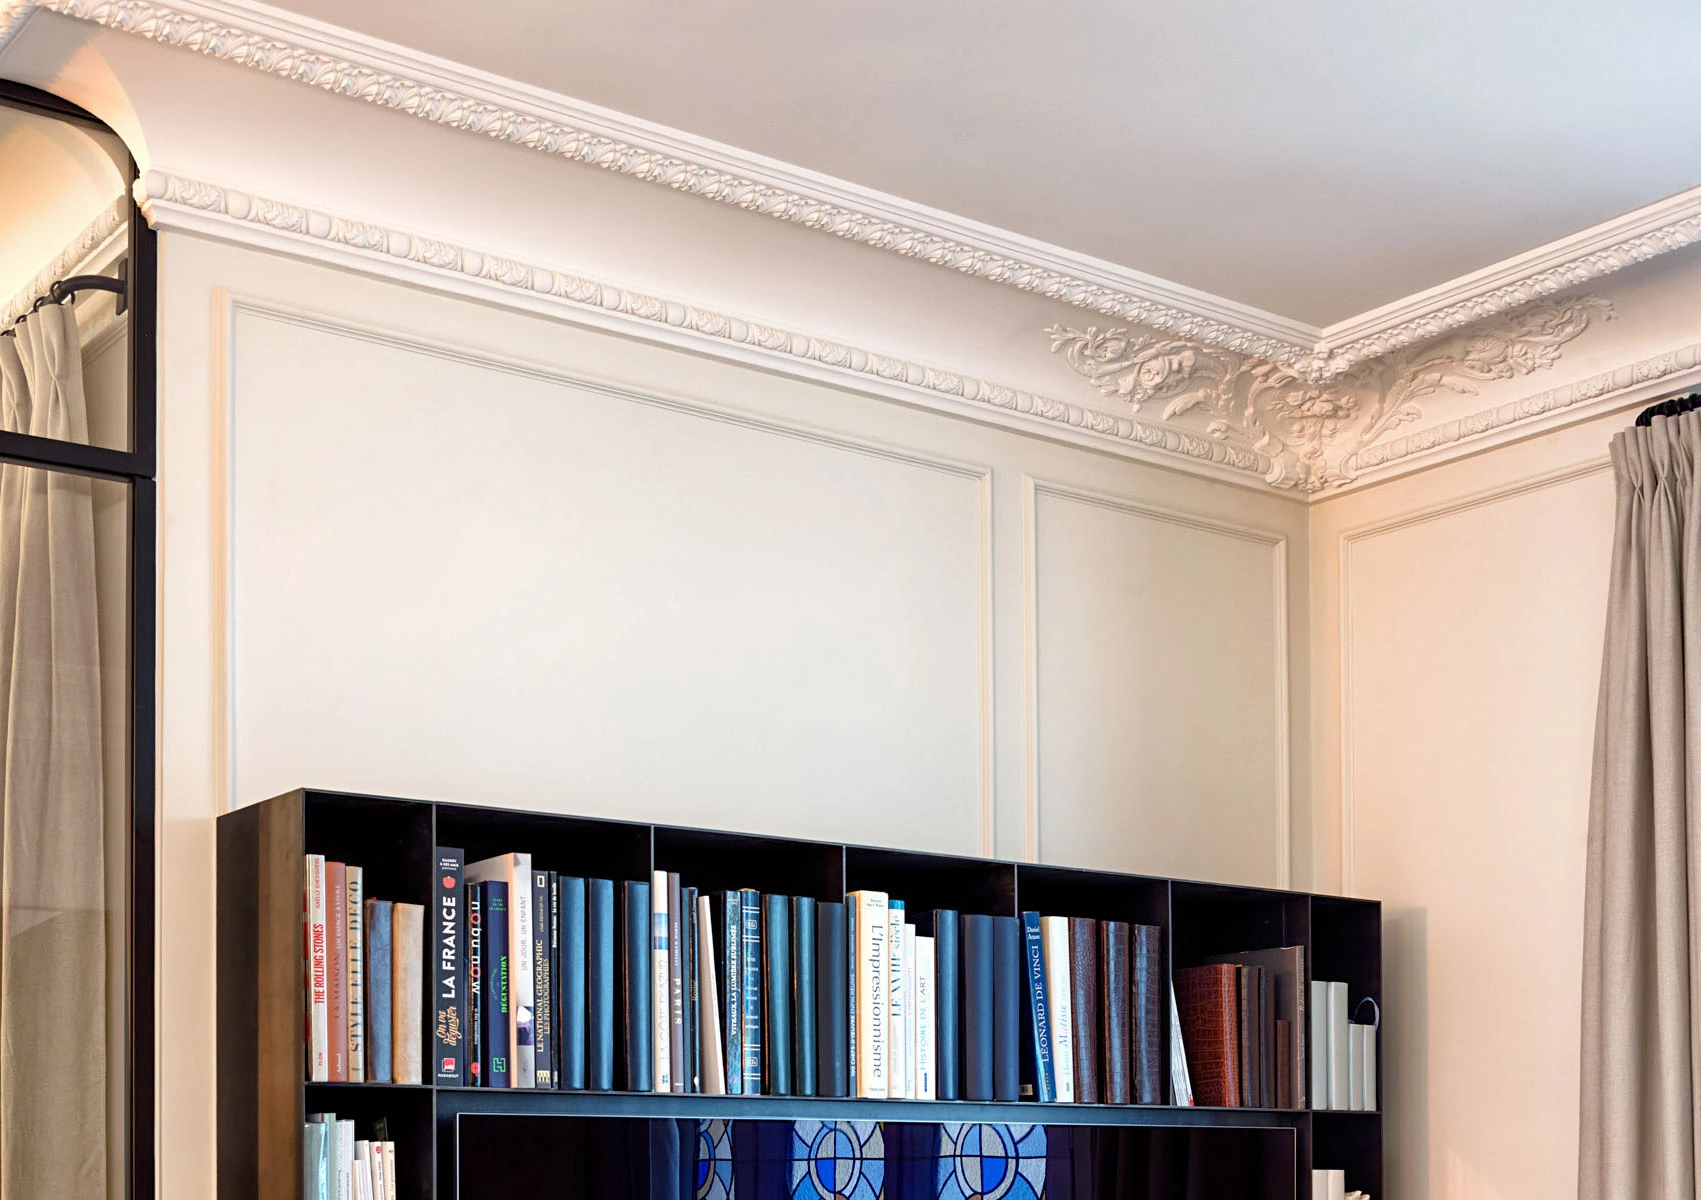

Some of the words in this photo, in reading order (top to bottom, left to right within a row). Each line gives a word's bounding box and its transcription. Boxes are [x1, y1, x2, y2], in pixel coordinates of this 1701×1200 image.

[348, 881, 360, 931] DECO
[312, 923, 324, 954] STONES
[441, 896, 456, 971] FRANCE
[470, 901, 482, 948] nobu
[520, 924, 527, 935] UN
[728, 924, 737, 959] SUBLIMÉE
[889, 914, 901, 950] siècle
[313, 955, 325, 988] ROLLING
[332, 953, 340, 1002] MAISON
[470, 955, 482, 994] now
[521, 960, 528, 971] UN
[535, 939, 543, 996] GEOGRAPHIC
[728, 960, 737, 991] LUMIÈRE
[1031, 945, 1042, 980] VINCI
[313, 989, 324, 1005] THE
[442, 975, 456, 998] LA
[499, 956, 508, 1014] DÉGUSTATION
[542, 958, 550, 1021] PHOTOGRAPHIES
[673, 977, 682, 1025] PARIS
[730, 992, 737, 1002] LA
[869, 924, 885, 1079] L'Impressionnisme
[1035, 983, 1044, 1001] DE
[437, 1010, 447, 1023] va
[443, 1005, 463, 1047] déguster
[536, 997, 544, 1041] NATIONAL
[657, 1006, 668, 1041] CÔTE
[919, 1007, 927, 1020] DE
[1058, 1004, 1069, 1048] Matisse
[436, 1024, 447, 1039] On
[537, 1042, 544, 1053] LE
[919, 1024, 928, 1071] HISTOIRE
[1035, 1002, 1050, 1063] LEONARD
[659, 1046, 668, 1060] LA
